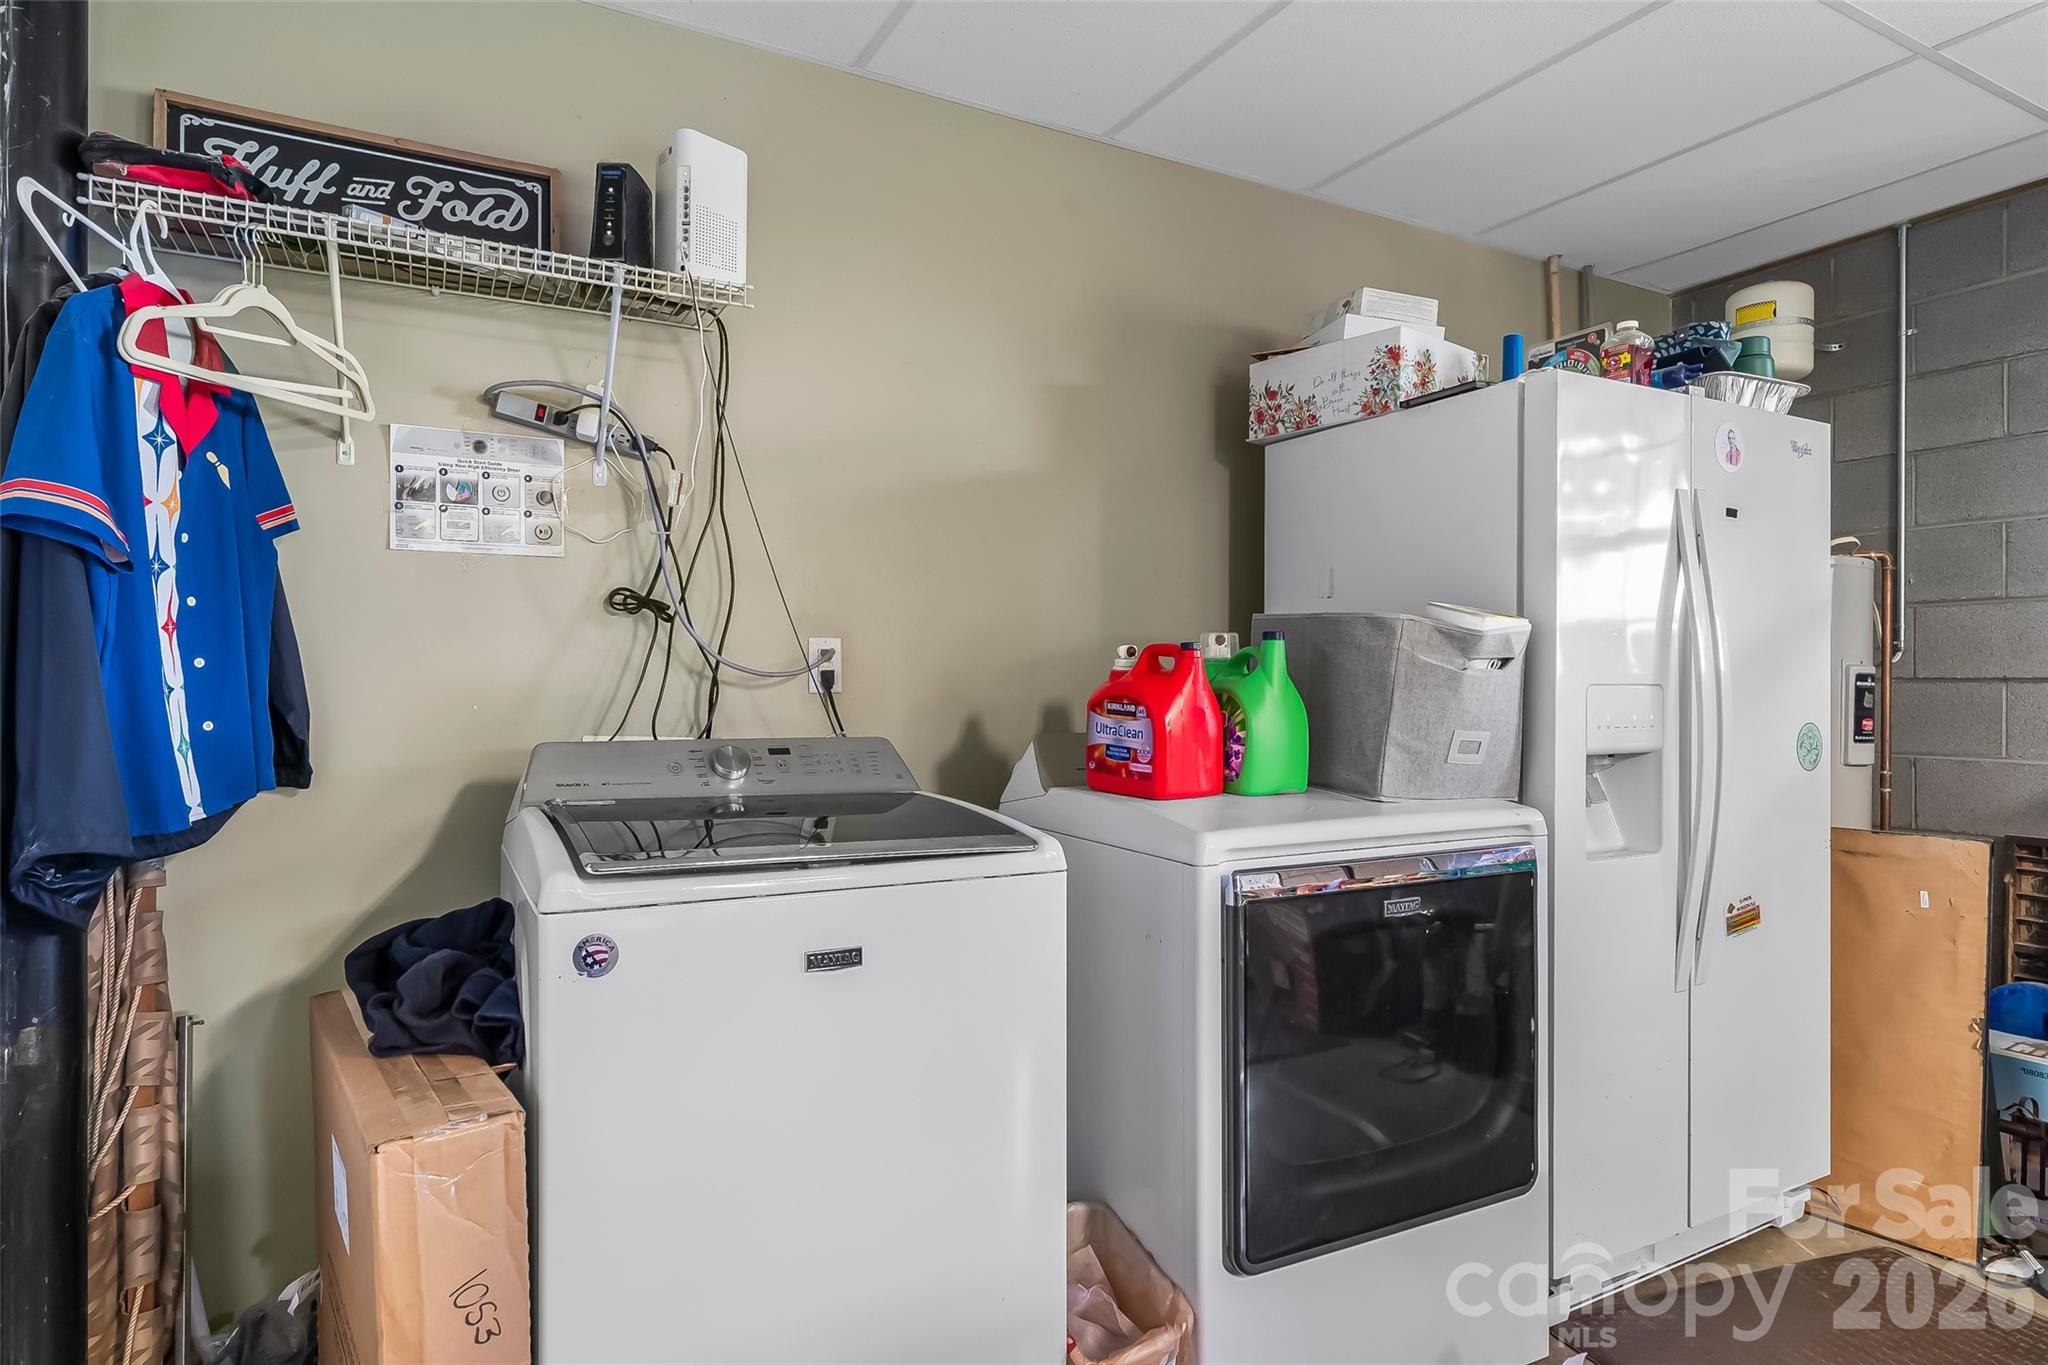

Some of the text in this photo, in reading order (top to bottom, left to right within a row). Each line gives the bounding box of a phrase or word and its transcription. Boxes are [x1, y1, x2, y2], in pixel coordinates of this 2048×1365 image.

[346, 178, 396, 200] and
[397, 176, 530, 232] Fold
[1107, 702, 1136, 712] KIRKLAND
[1095, 721, 1144, 740] UltraClean
[1387, 900, 1419, 914] MAYTAG
[577, 936, 616, 953] AMERICA
[809, 951, 861, 968] MAYTAG
[449, 1268, 502, 1345] 1053
